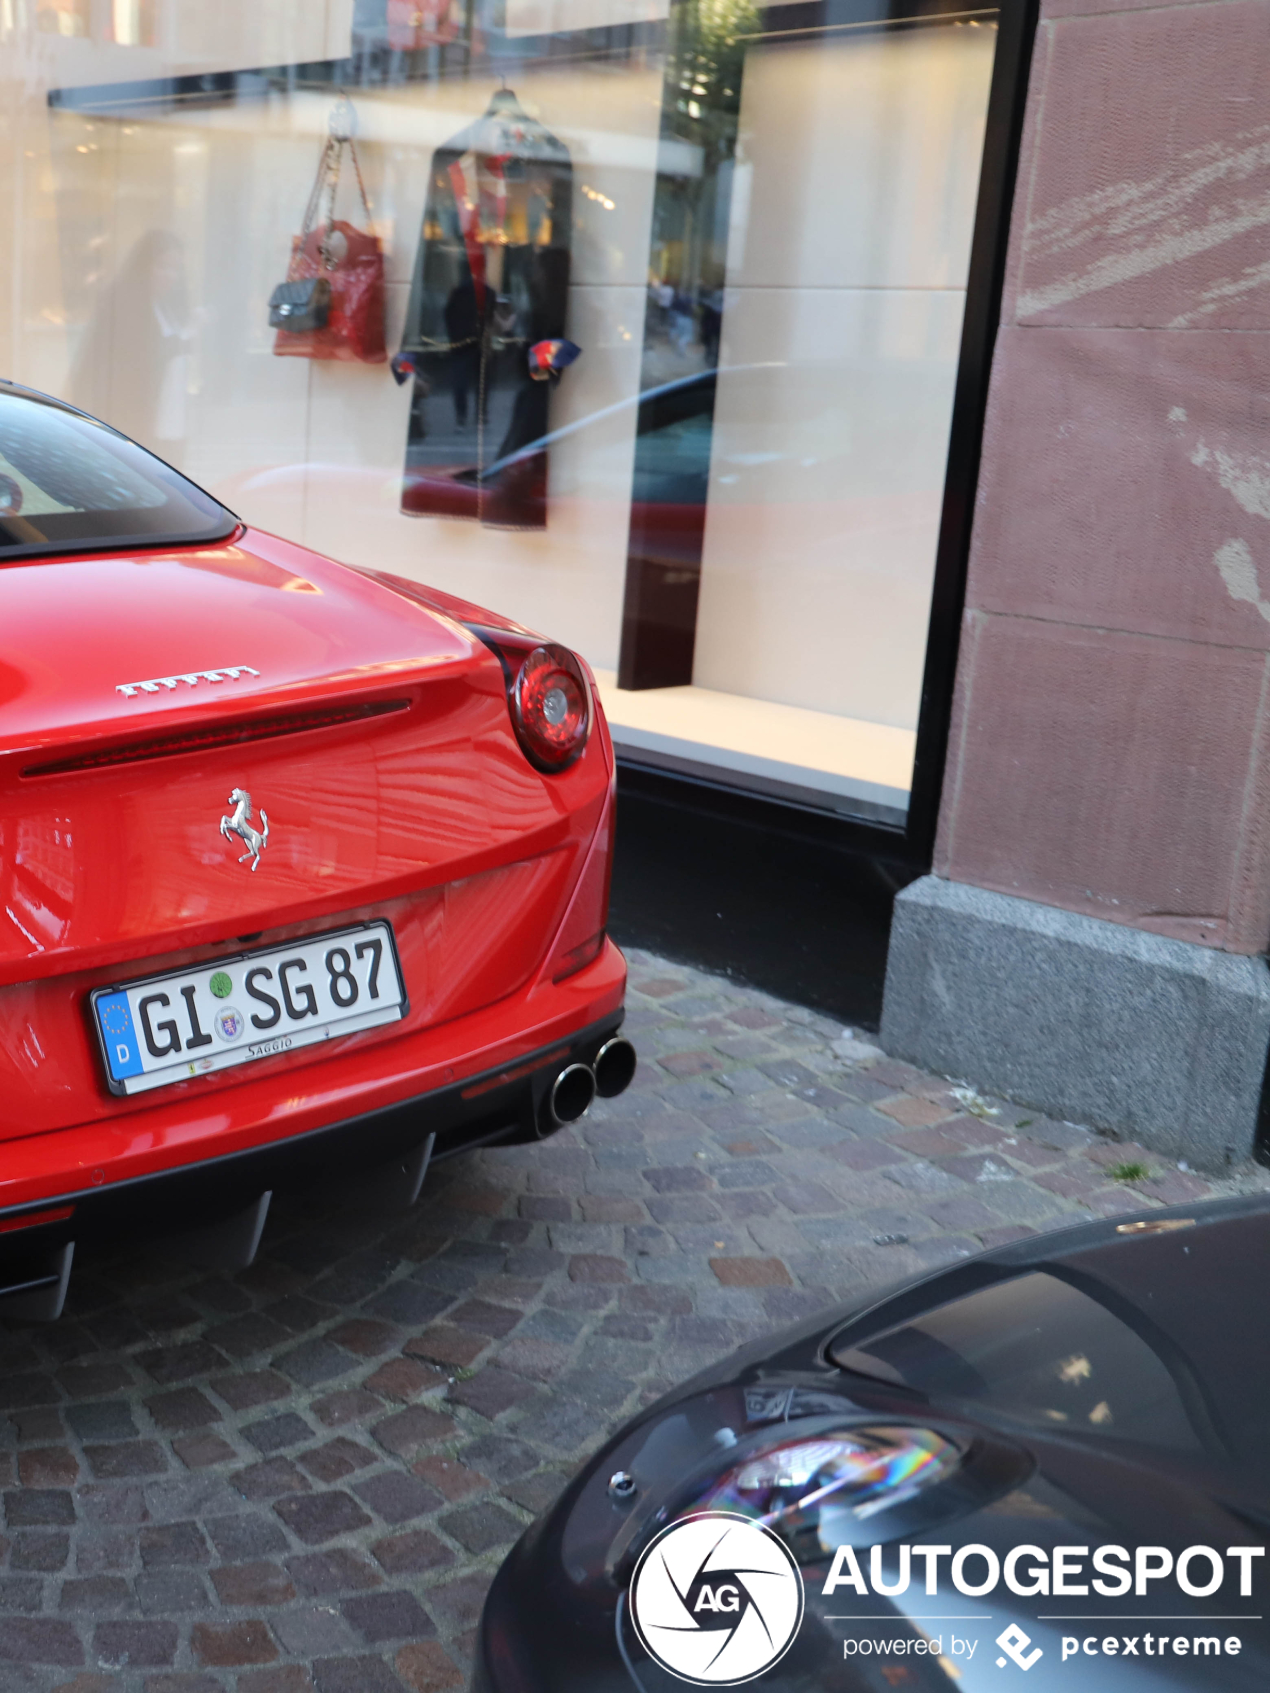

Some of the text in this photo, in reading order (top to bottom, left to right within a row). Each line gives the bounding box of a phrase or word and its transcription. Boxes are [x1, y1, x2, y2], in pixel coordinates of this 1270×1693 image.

[116, 666, 260, 697] Ferrari
[138, 939, 383, 1057] GI SG 87
[117, 1044, 130, 1064] D
[246, 1037, 293, 1058] SAGGIO
